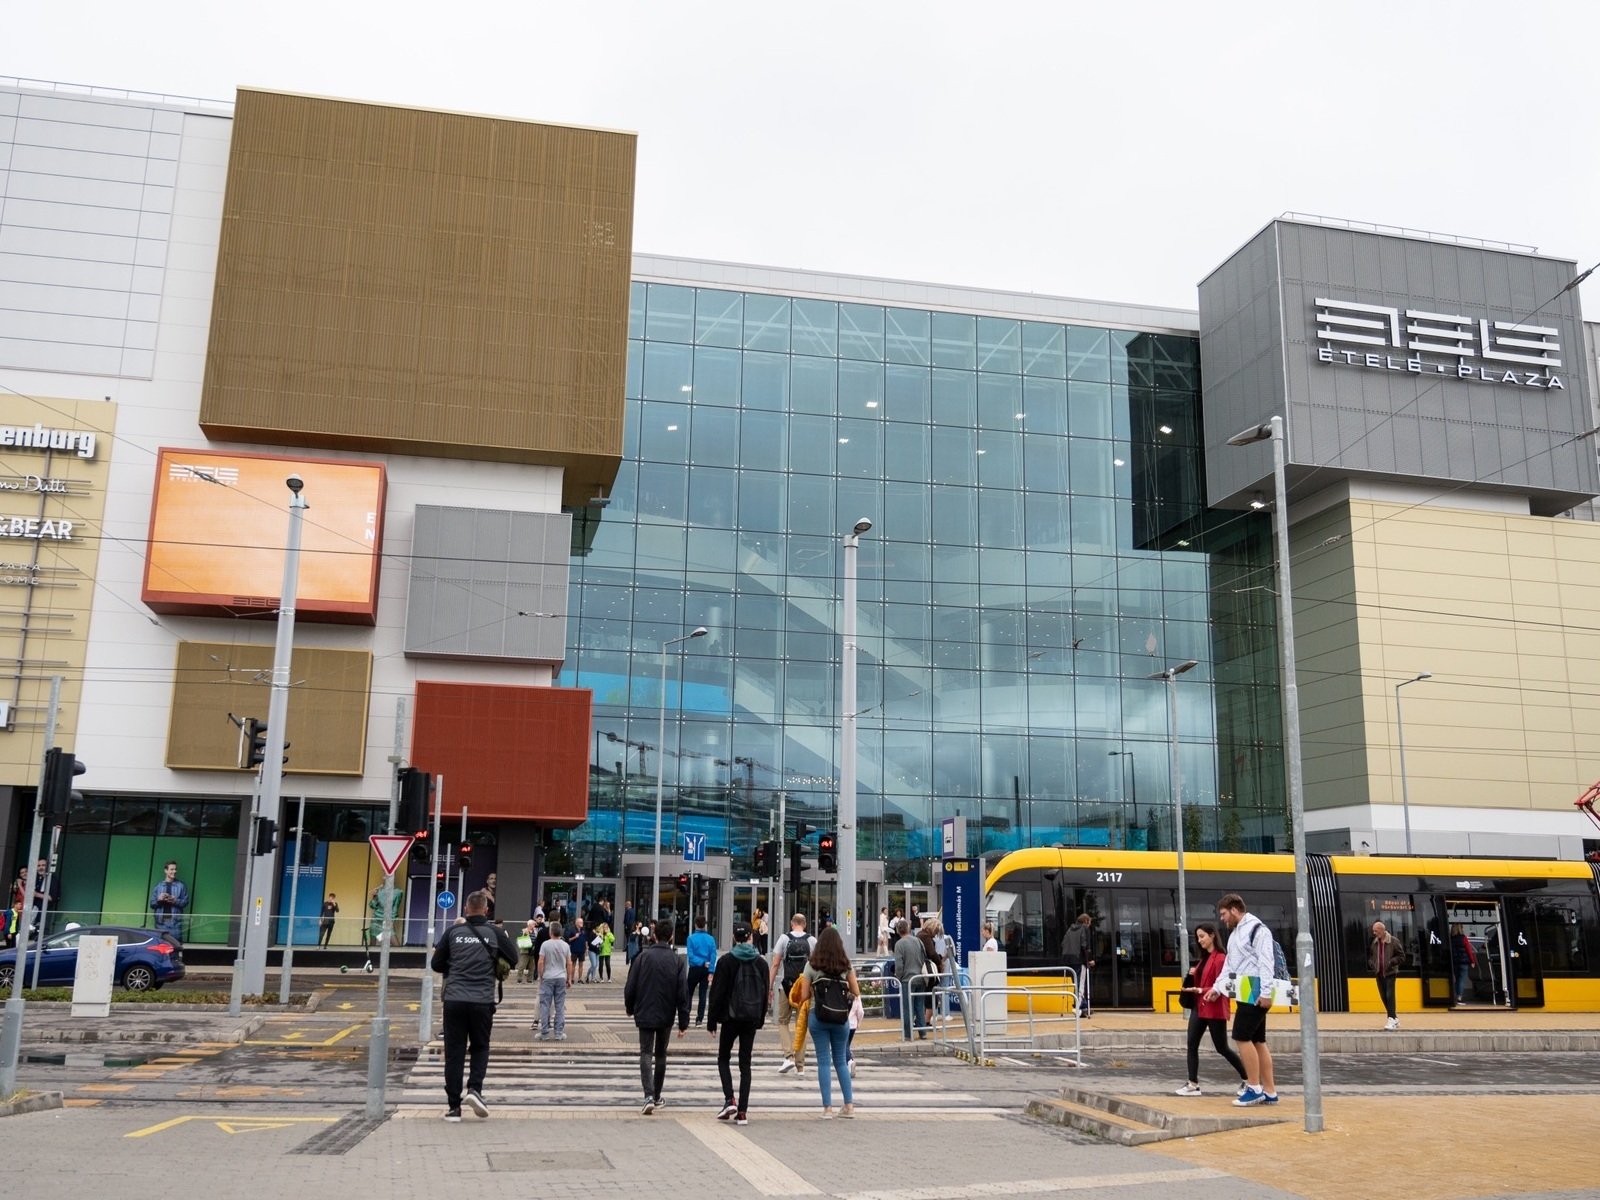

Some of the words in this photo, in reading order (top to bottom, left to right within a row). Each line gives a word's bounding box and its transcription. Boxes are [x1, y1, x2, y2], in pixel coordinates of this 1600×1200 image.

[1318, 347, 1422, 373] ETELE
[1457, 364, 1565, 390] PLAZA
[0, 422, 96, 458] enburg
[24, 475, 68, 493] Dutti
[1096, 872, 1123, 882] 2117
[956, 886, 962, 894] M
[455, 936, 463, 944] SC
[464, 936, 490, 944] SOPRN
